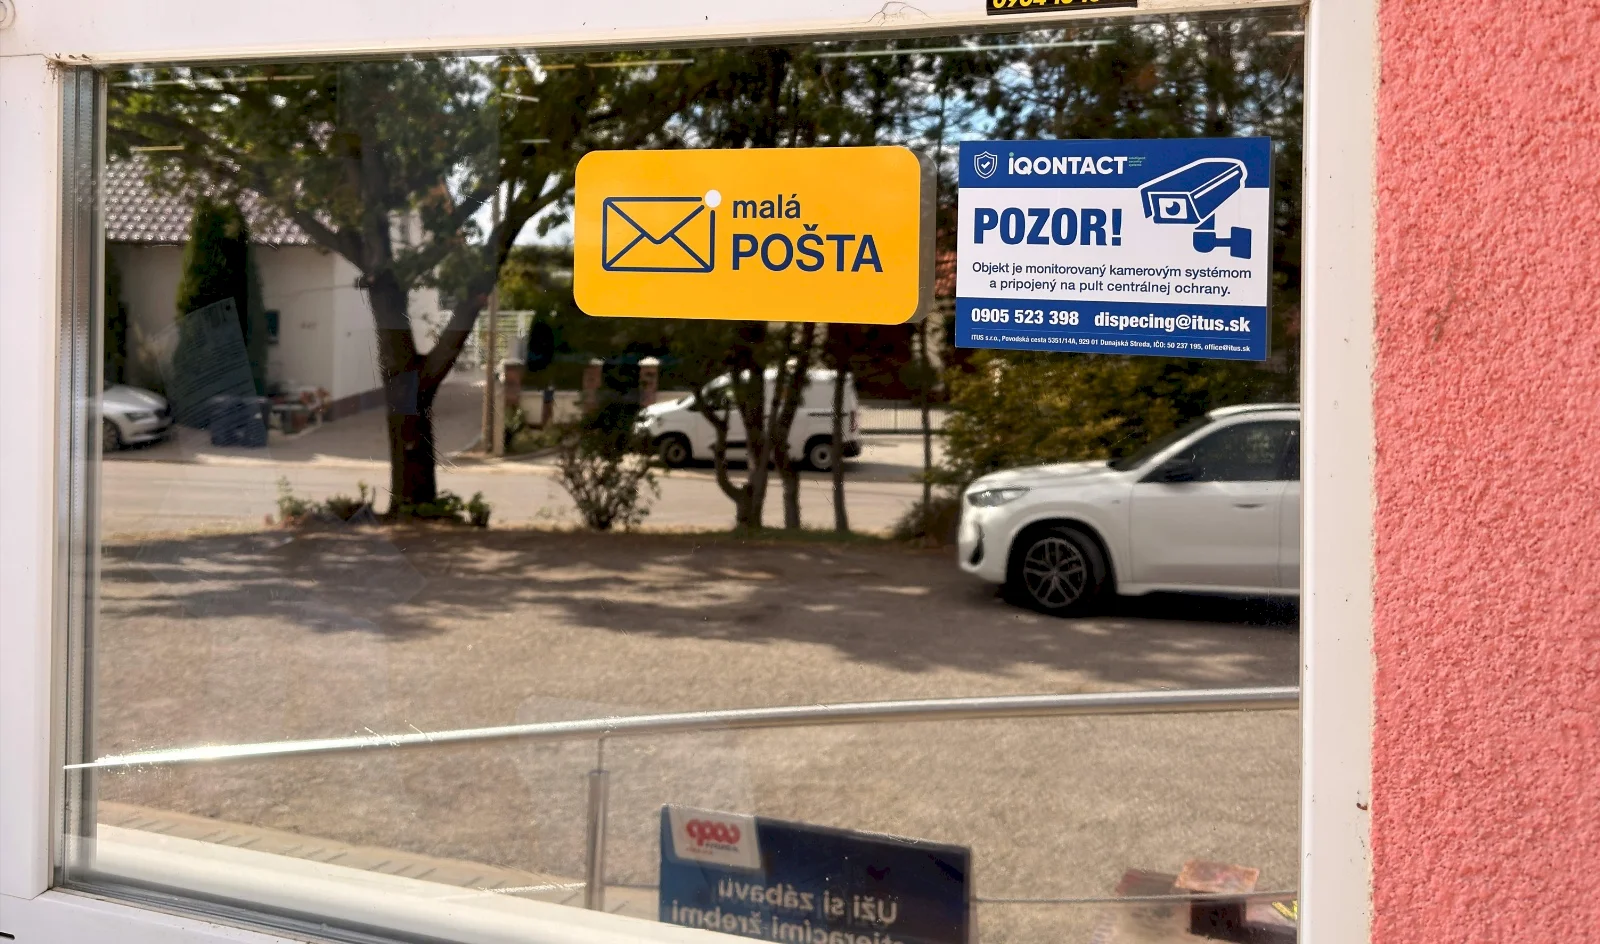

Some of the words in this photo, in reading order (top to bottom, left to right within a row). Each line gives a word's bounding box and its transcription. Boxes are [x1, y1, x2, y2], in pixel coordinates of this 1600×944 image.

[732, 193, 801, 219] malá
[973, 207, 1123, 247] POZOR!
[732, 223, 884, 273] POŠTA
[972, 261, 1010, 276] Objekt
[1011, 262, 1023, 276] je
[1025, 263, 1107, 278] monitorovaný
[1109, 264, 1182, 280] kamerovým
[1184, 266, 1252, 280] systémom
[989, 279, 997, 289] a
[1000, 278, 1057, 293] pripojený
[1060, 281, 1076, 291] na
[1079, 280, 1104, 293] pult
[1106, 281, 1171, 296] centrálnej
[1174, 282, 1231, 298] ochrany.
[971, 307, 1010, 324] 0905
[1014, 309, 1044, 325] 523
[1048, 310, 1080, 326] 398
[1094, 311, 1251, 332] dispecing@itus.sk
[1204, 344, 1250, 352] office@itus.sk
